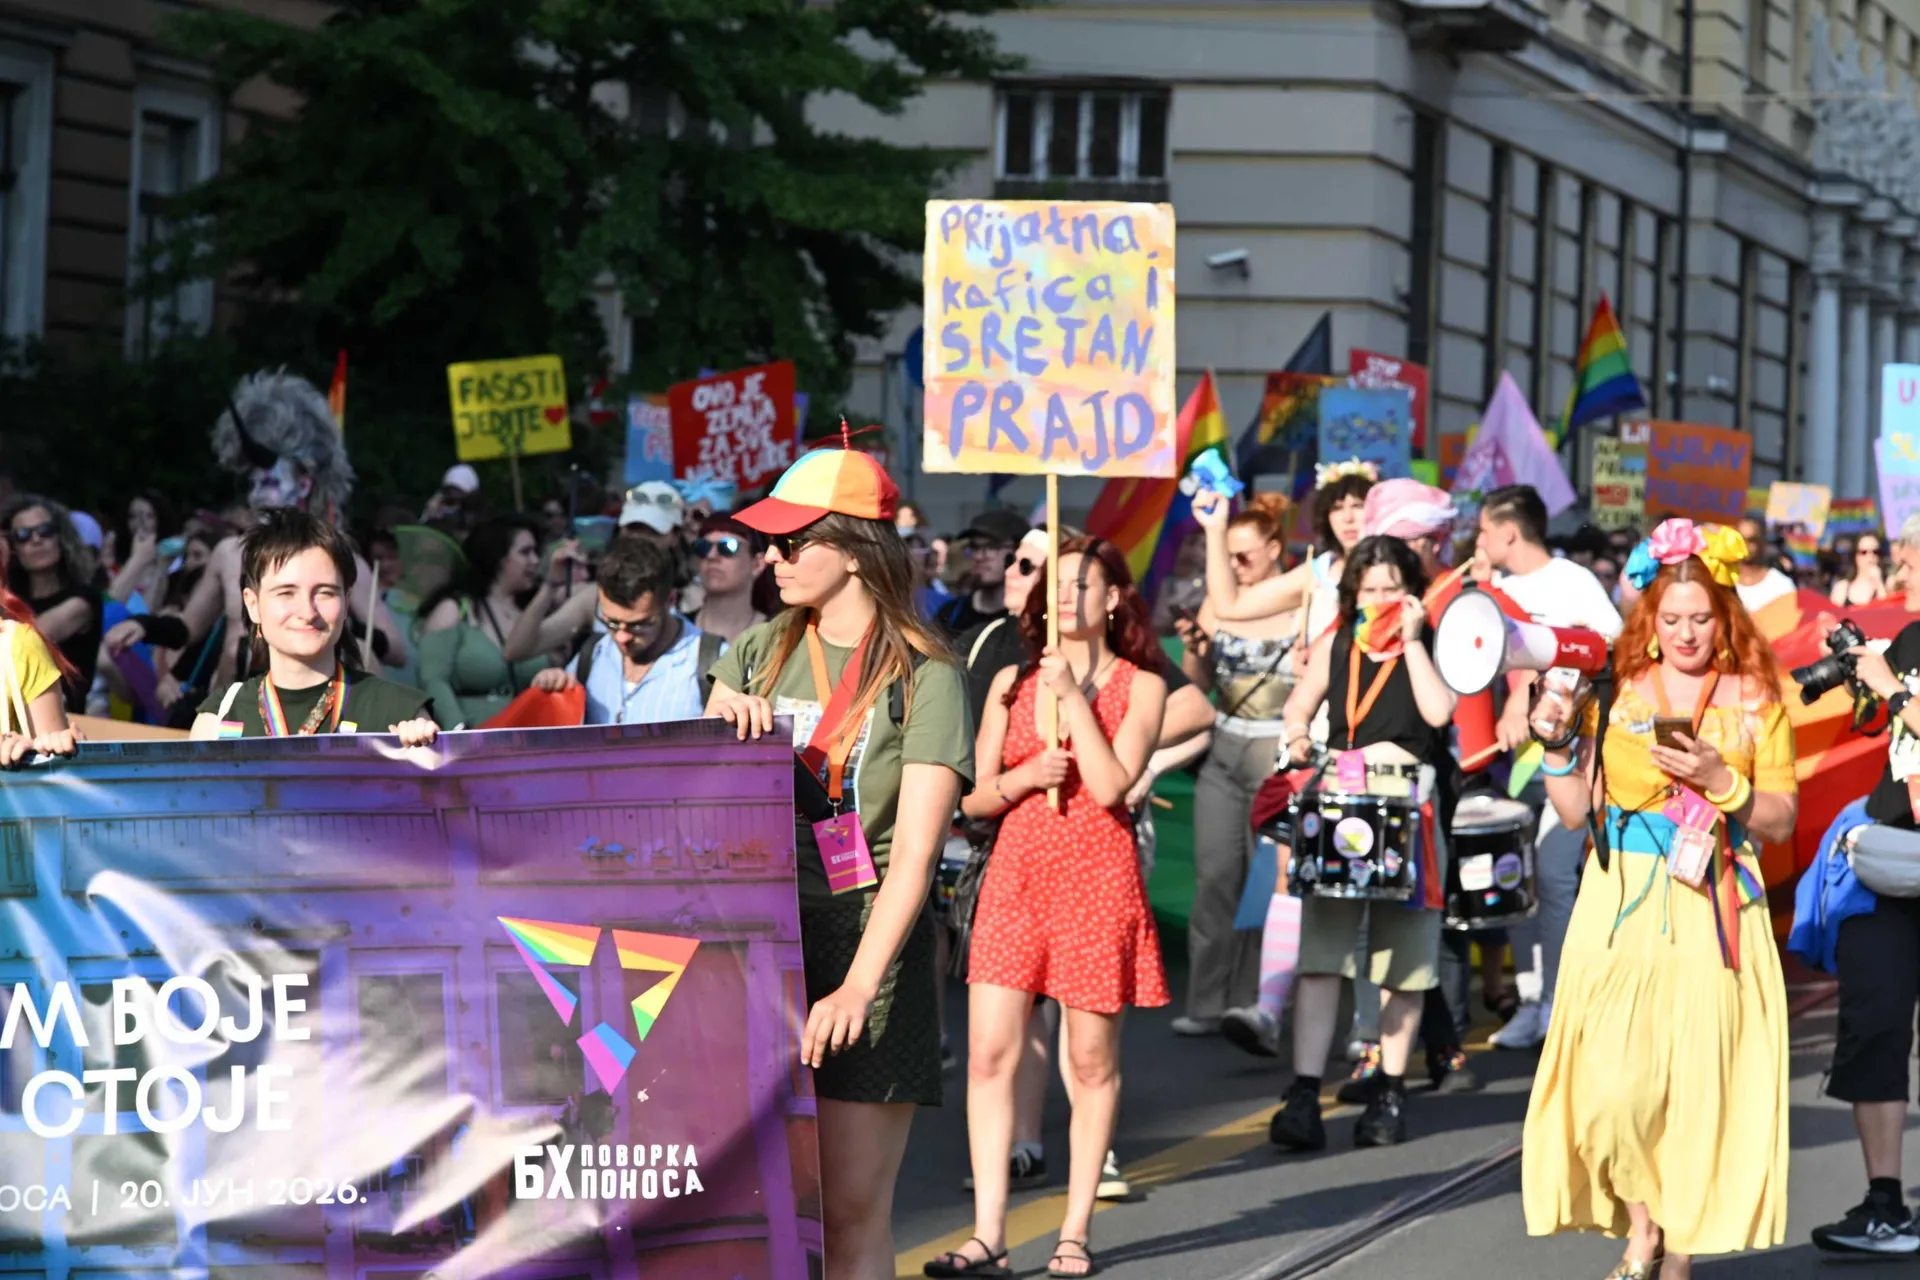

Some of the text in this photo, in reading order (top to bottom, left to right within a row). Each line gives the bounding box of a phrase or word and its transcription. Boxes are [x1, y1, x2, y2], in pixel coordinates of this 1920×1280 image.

[941, 311, 1153, 376] SRETAN
[692, 372, 766, 411] OVO JE
[698, 434, 732, 462] ZA
[949, 380, 1156, 471] PRAJD
[112, 973, 311, 1046] БОЈЕ
[22, 1064, 294, 1139] СТОЈЕ
[514, 1144, 575, 1199] БХ
[581, 1144, 699, 1167] ПОВОРКА
[120, 1179, 171, 1209] 20.
[267, 1177, 368, 1206] 2026.
[581, 1168, 705, 1199] ПОНОСА
